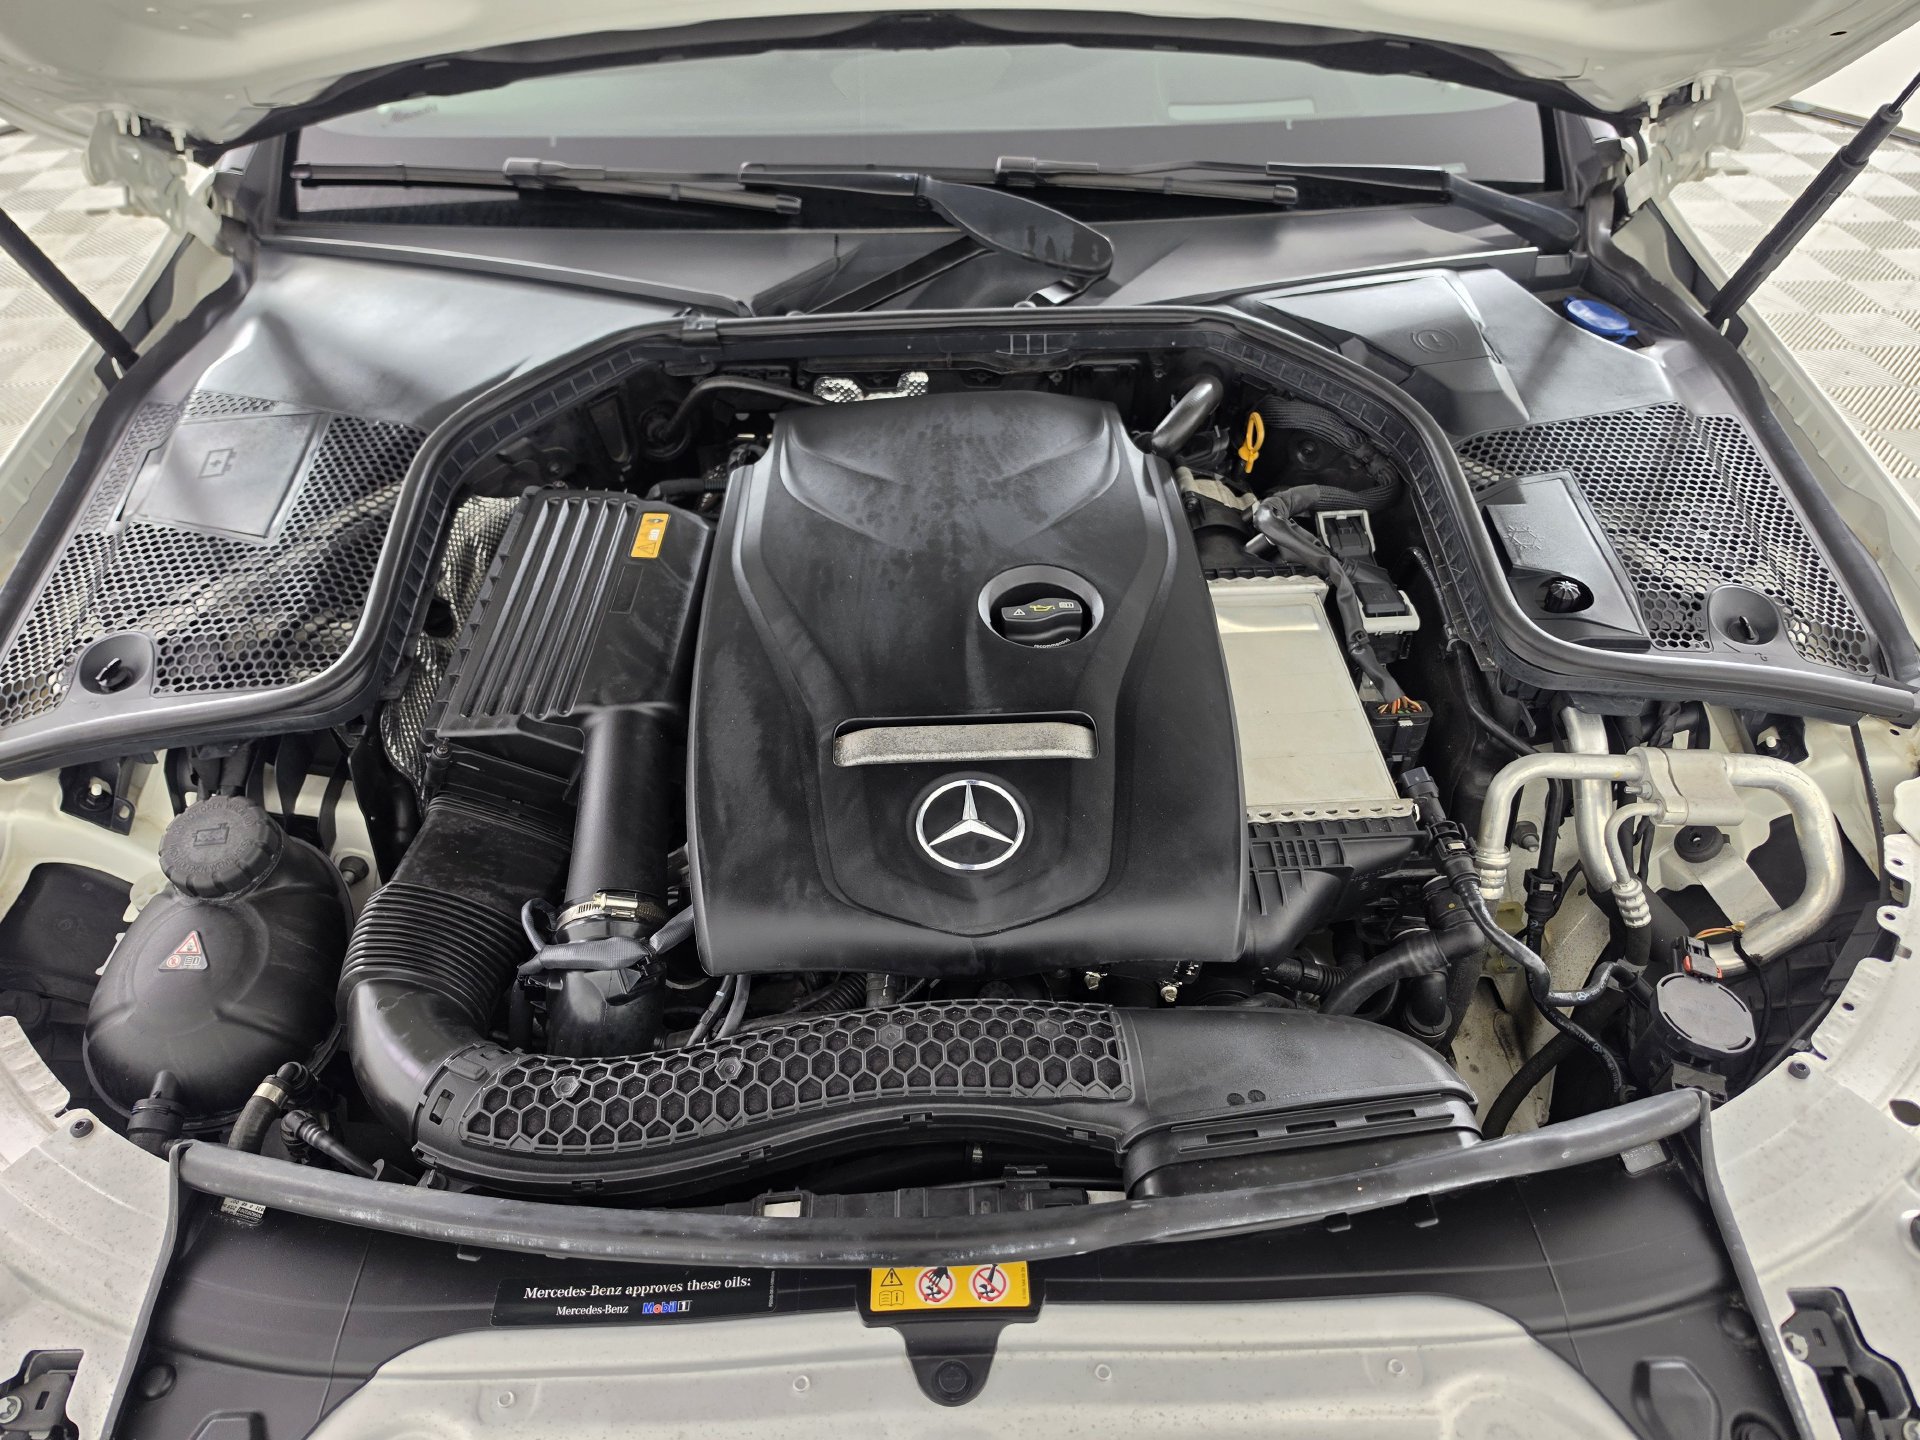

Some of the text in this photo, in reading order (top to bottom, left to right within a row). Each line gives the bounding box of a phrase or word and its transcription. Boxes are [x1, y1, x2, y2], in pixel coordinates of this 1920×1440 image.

[523, 1276, 751, 1299] Mercedes-Benz approves these oils:
[555, 1304, 629, 1316] Mercedes-Benz
[642, 1301, 677, 1314] Mobil
